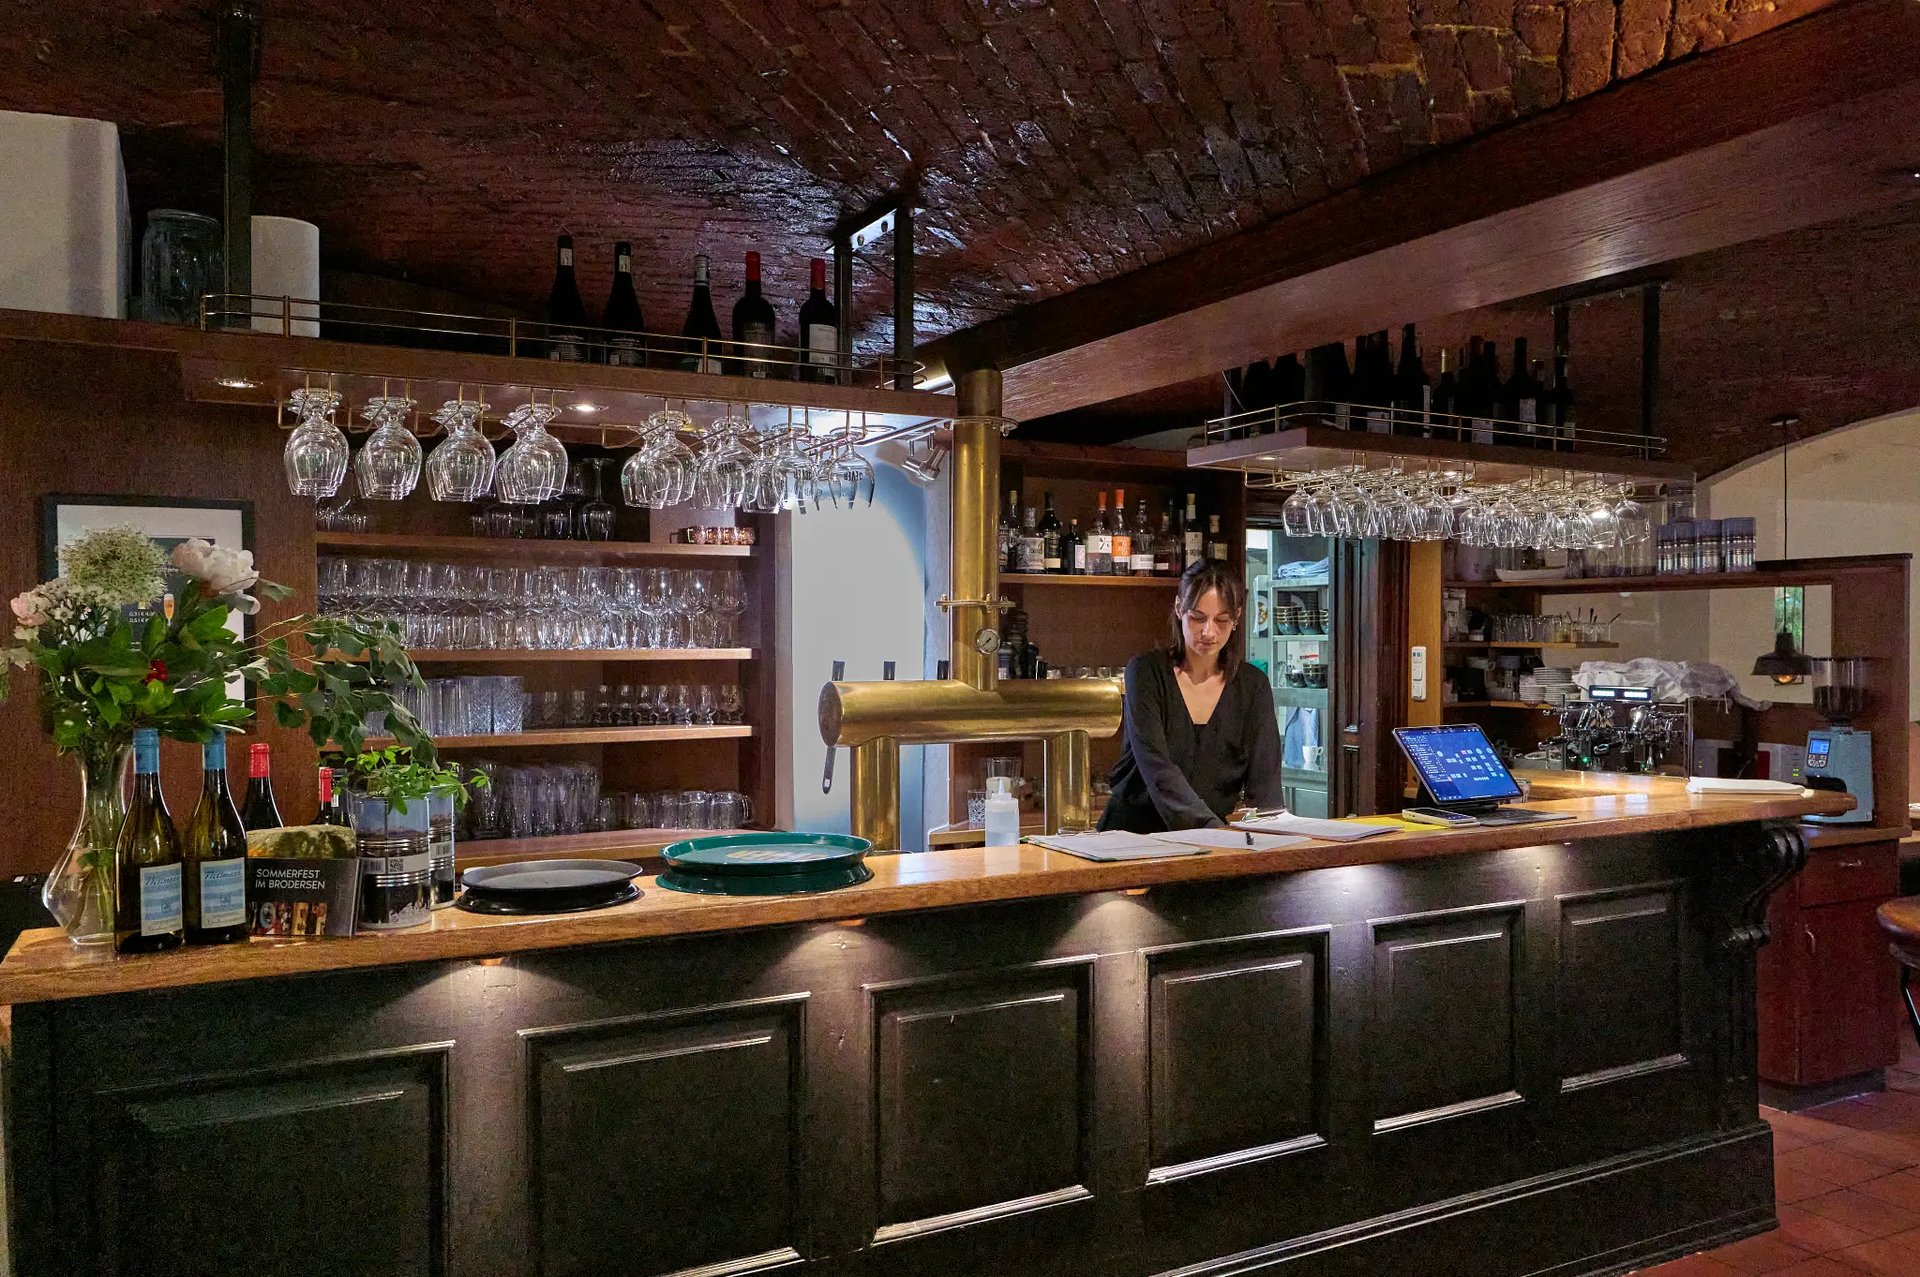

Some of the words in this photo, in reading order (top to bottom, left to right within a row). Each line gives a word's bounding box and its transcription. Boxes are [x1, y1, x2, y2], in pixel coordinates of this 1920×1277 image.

[256, 868, 320, 878] SOMMERFEST
[255, 880, 266, 888] IM
[268, 880, 326, 890] BRODERSEN
